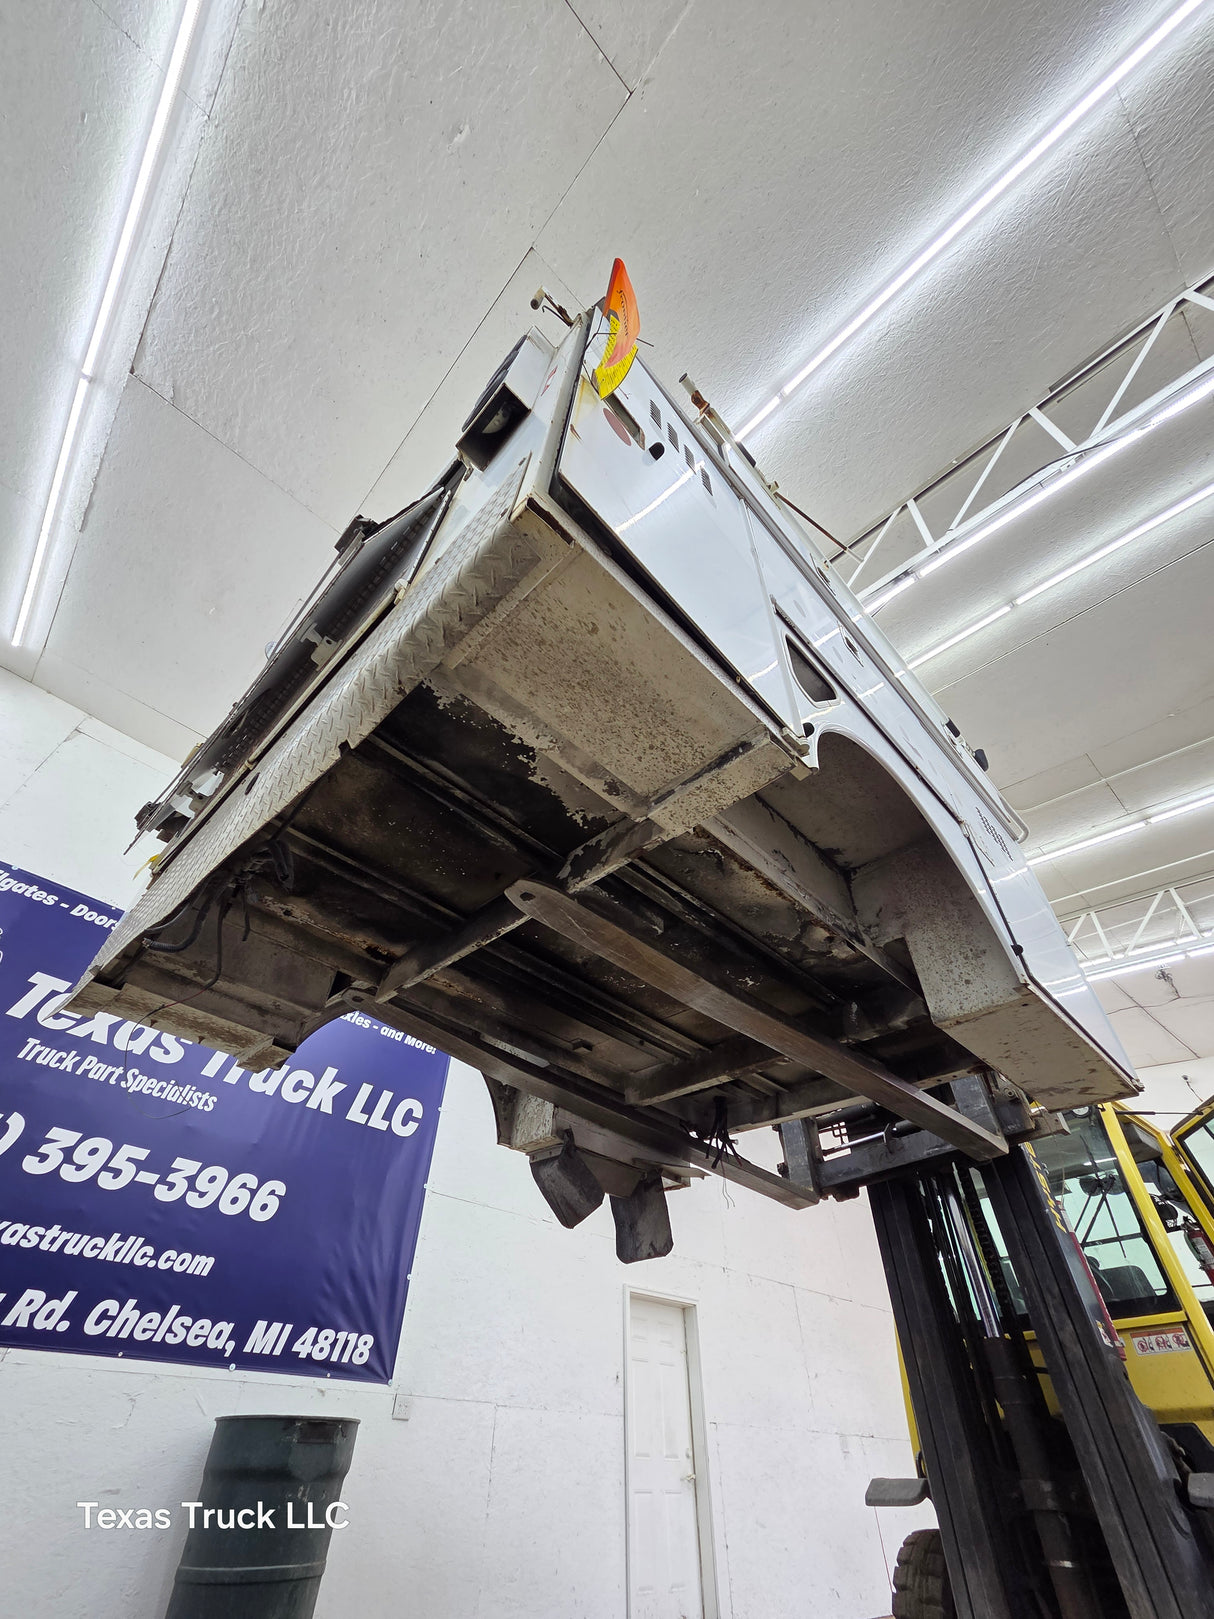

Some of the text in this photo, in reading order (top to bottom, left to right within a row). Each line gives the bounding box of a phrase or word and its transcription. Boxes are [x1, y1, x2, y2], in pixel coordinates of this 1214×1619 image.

[6, 971, 192, 1064] Texas
[345, 1082, 424, 1137] LLC
[340, 1011, 371, 1029] xles
[380, 1026, 404, 1041] and
[17, 1037, 218, 1112] Truck Part Specialists
[22, 1126, 287, 1222] 395-3966
[0, 1221, 215, 1276] astruckllc.com
[1, 1288, 374, 1365] Rd. Chelsea, MI 48118
